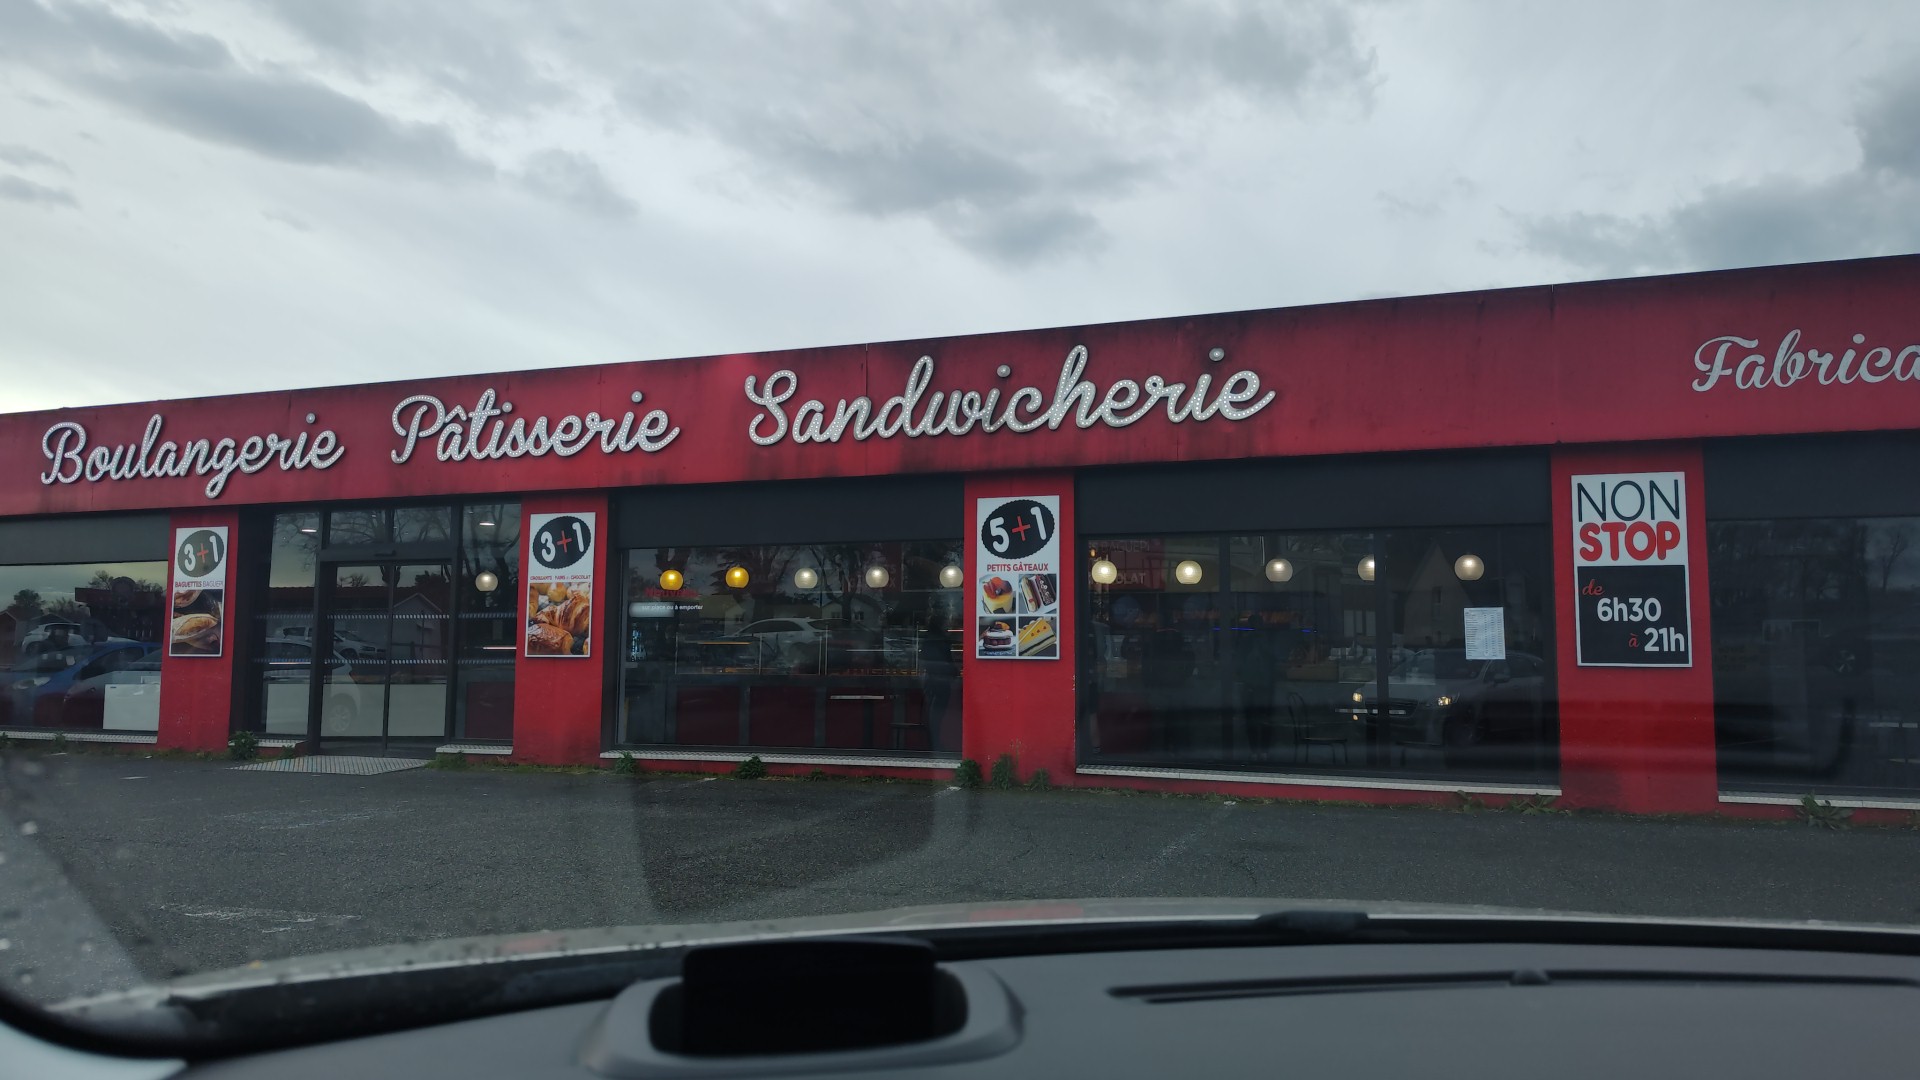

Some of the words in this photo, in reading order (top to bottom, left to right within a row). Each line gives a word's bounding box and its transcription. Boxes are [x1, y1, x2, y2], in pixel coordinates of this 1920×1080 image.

[41, 413, 345, 499] Boulangerie
[391, 388, 680, 464] Pâtisserie
[745, 344, 1276, 446] Sandwicherie
[1577, 479, 1680, 522] NON
[541, 522, 585, 562] 3+1
[990, 506, 1047, 553] 5+1
[1579, 521, 1681, 561] STOP
[184, 535, 219, 571] 3+1
[987, 563, 1011, 572] PETITS
[1012, 562, 1049, 572] GÂTEAUX
[1582, 579, 1605, 596] de
[679, 604, 703, 612] emporter
[1597, 597, 1662, 622] 6h30
[1628, 633, 1640, 648] à
[1643, 626, 1685, 652] 21h
